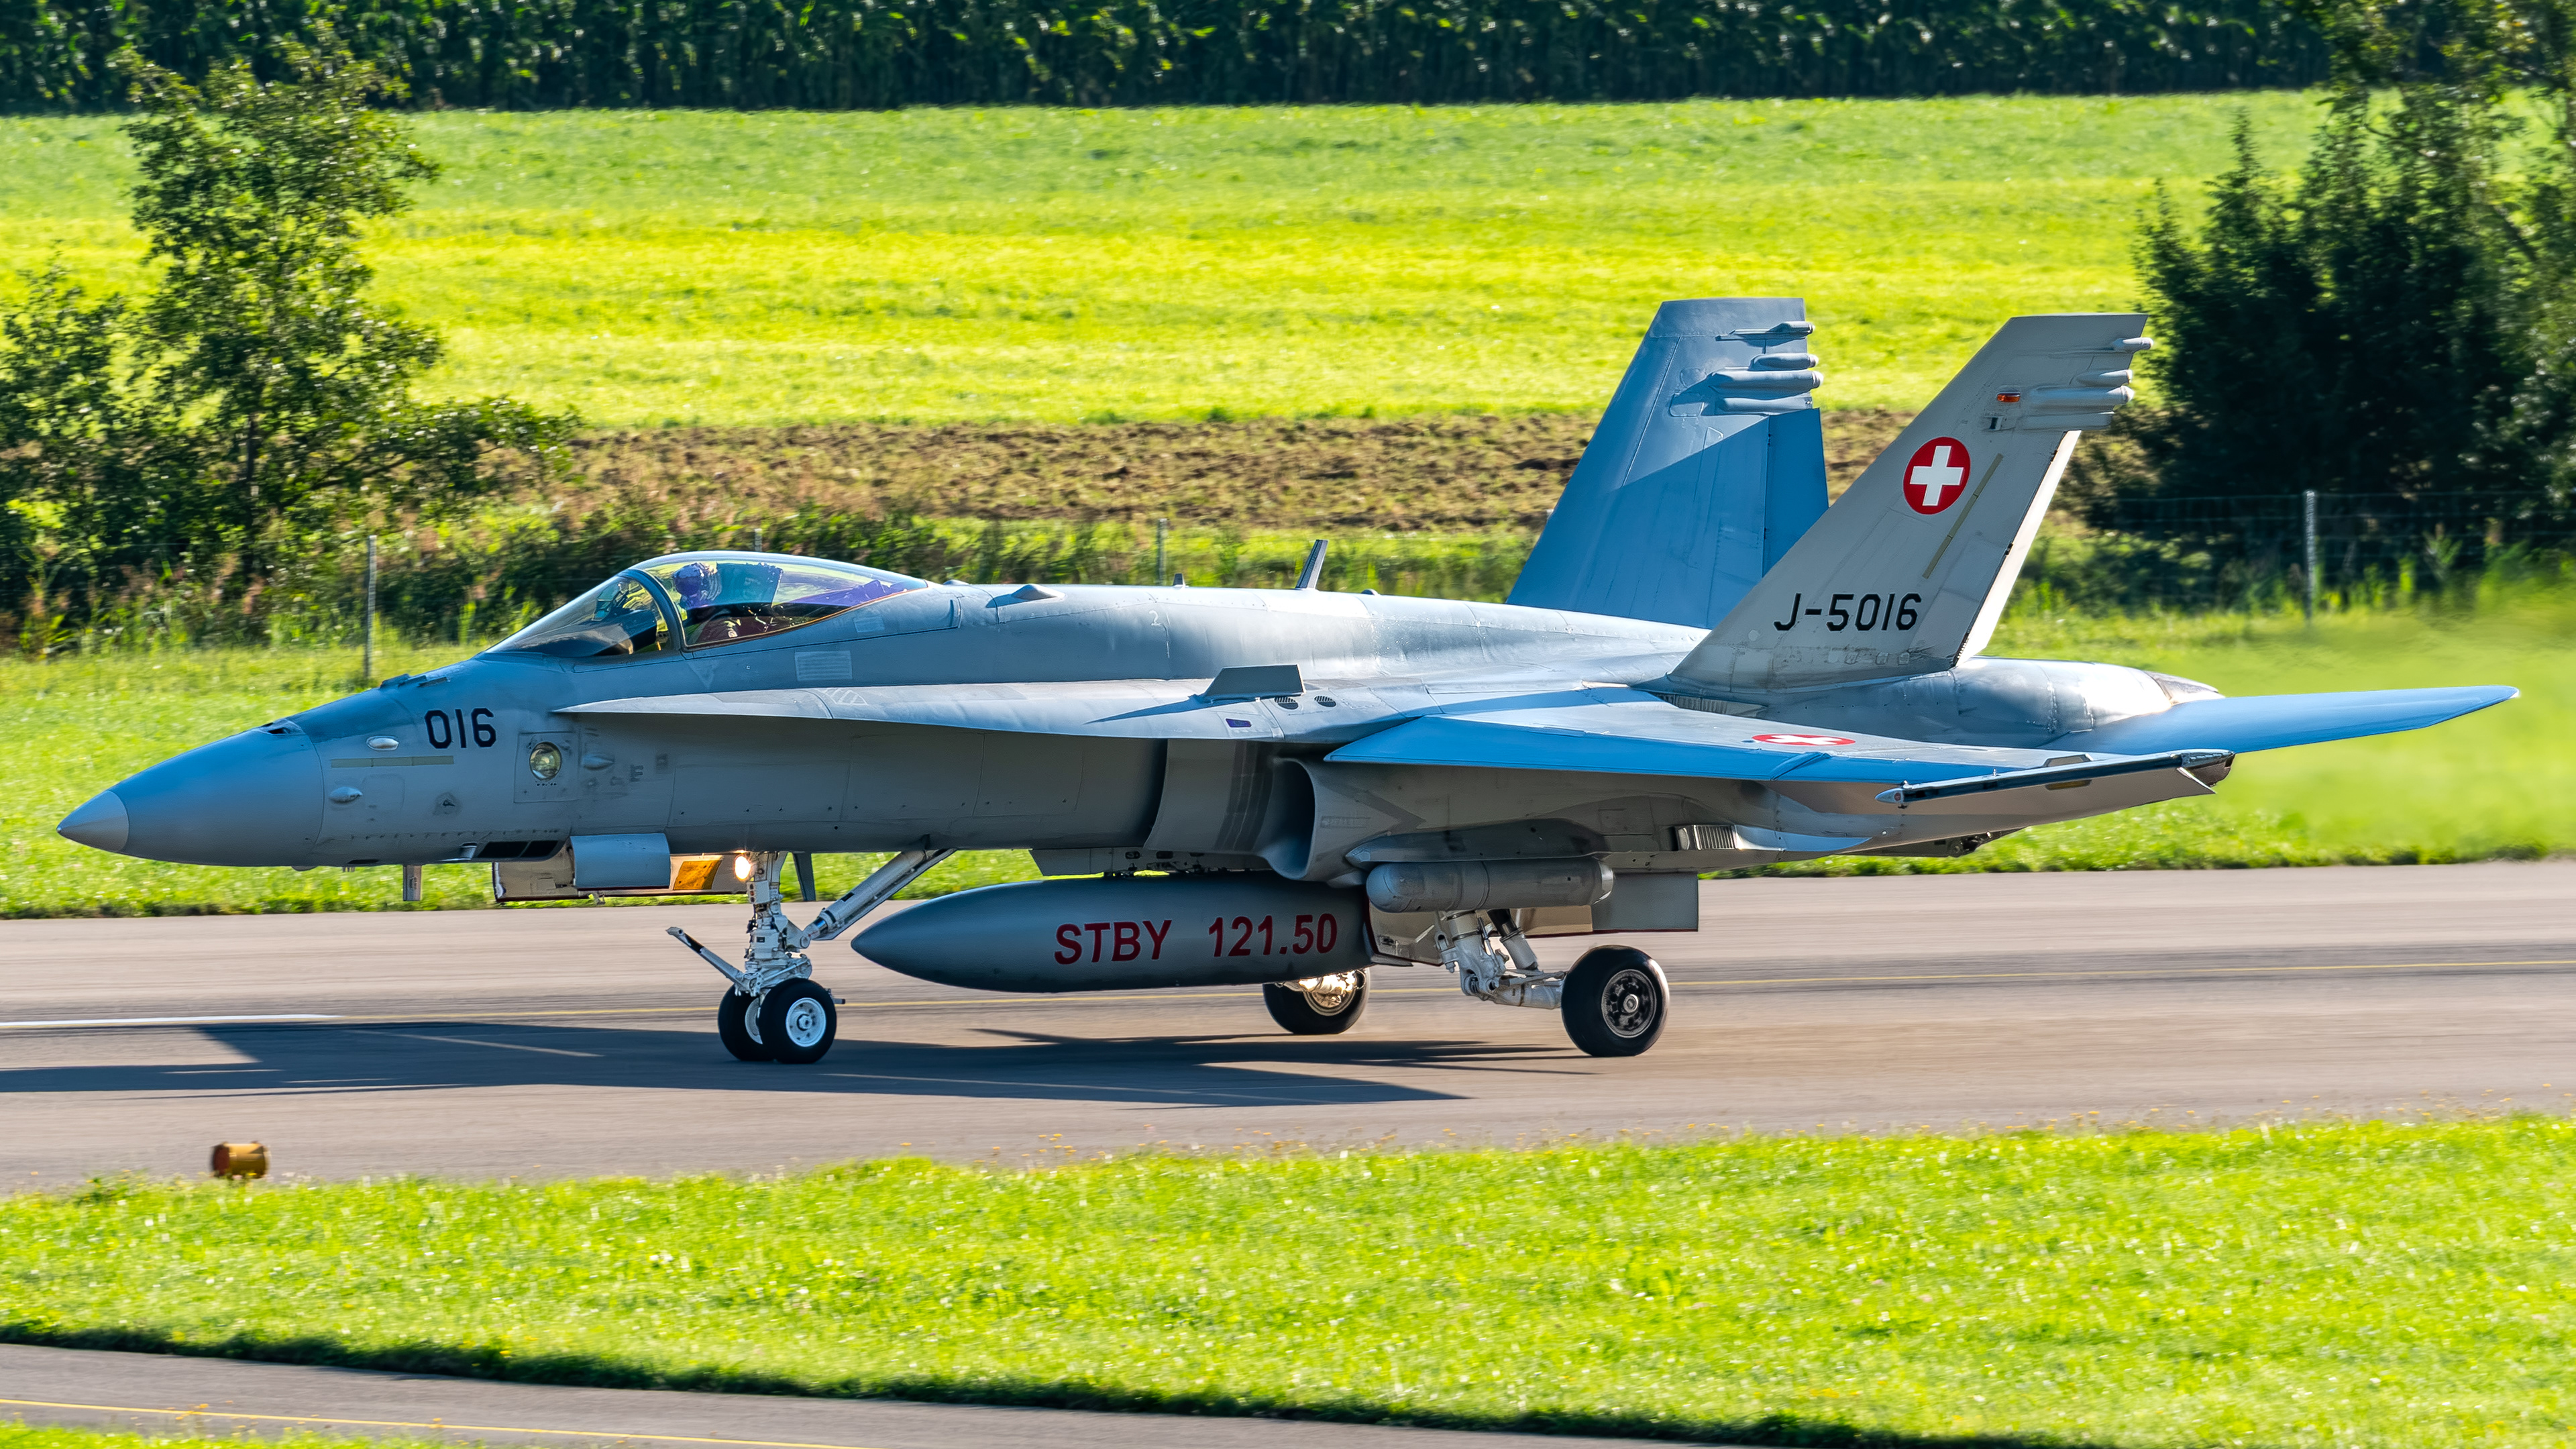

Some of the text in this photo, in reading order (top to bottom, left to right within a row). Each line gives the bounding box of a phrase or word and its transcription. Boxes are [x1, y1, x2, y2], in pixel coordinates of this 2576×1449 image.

[1773, 592, 1923, 632] J-5016
[423, 707, 497, 749] 016
[1054, 912, 1338, 965] STBY 121.50
